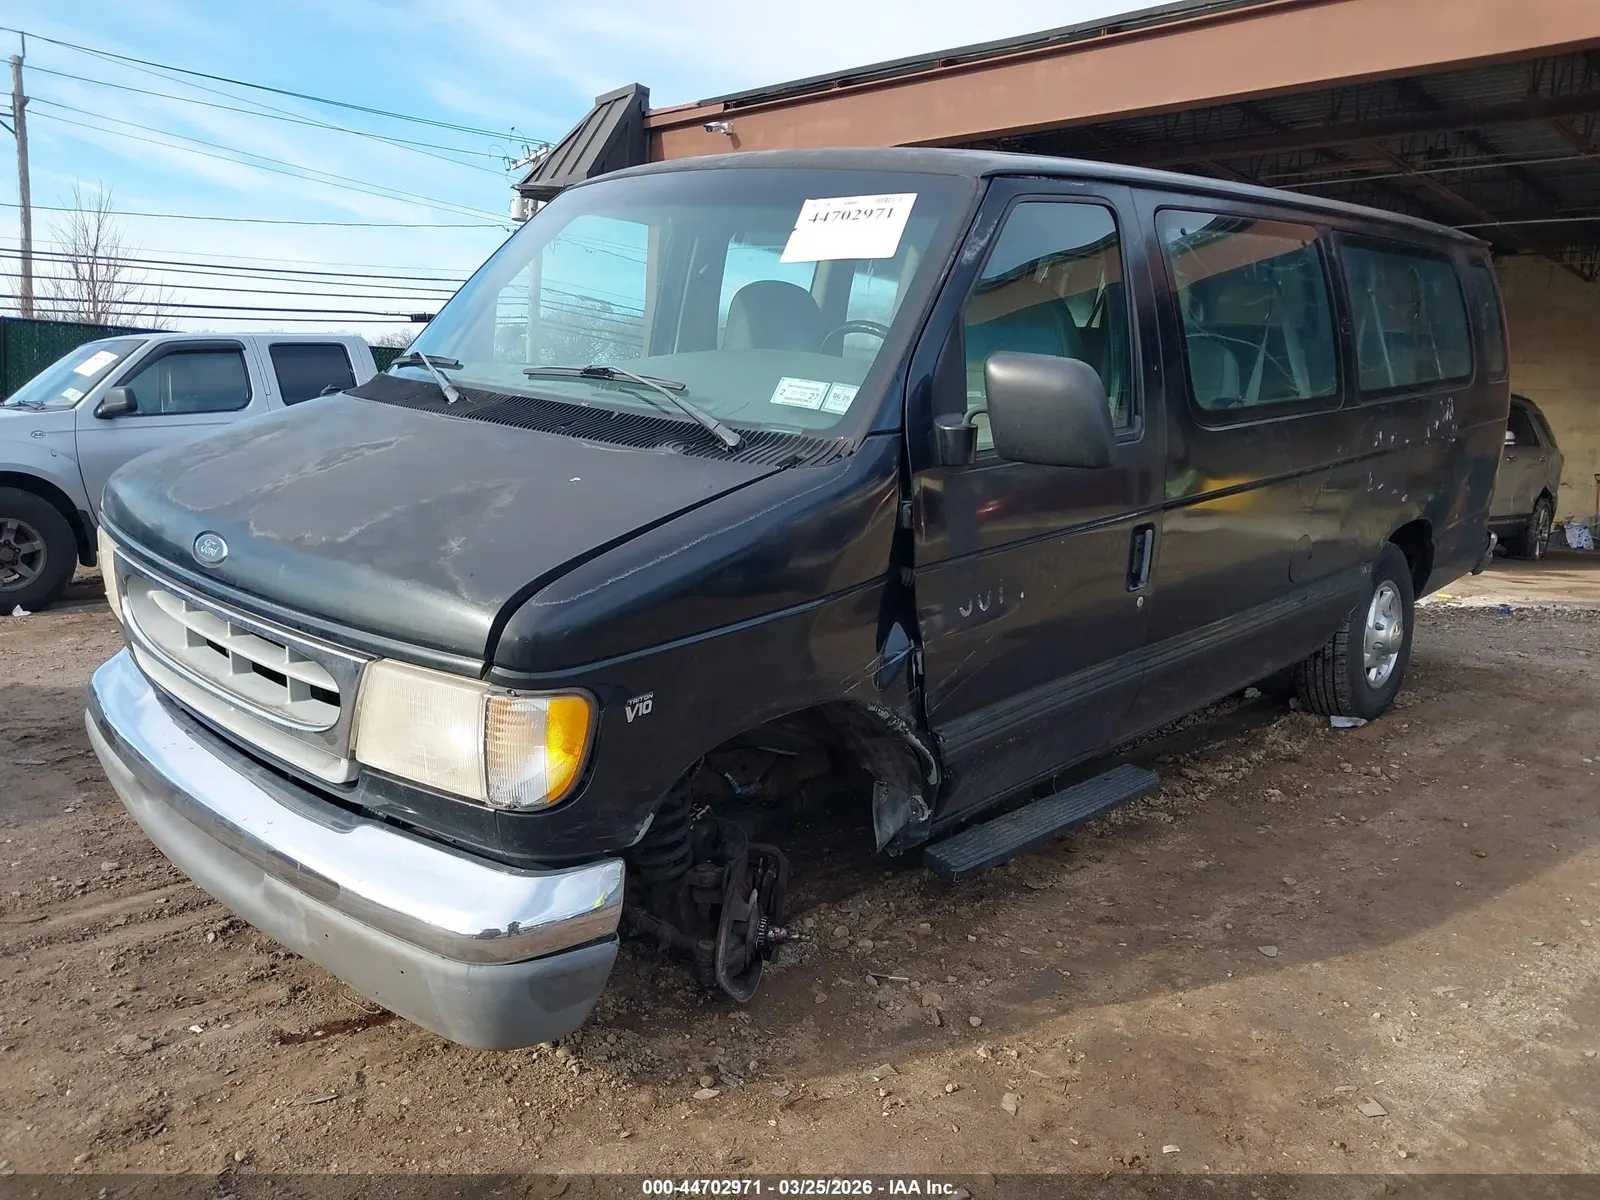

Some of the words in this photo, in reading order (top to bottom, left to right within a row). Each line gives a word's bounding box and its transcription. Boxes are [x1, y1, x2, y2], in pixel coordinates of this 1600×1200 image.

[808, 207, 895, 223] 44702971
[808, 392, 820, 401] 27
[201, 539, 220, 556] Ford
[625, 699, 653, 723] V10
